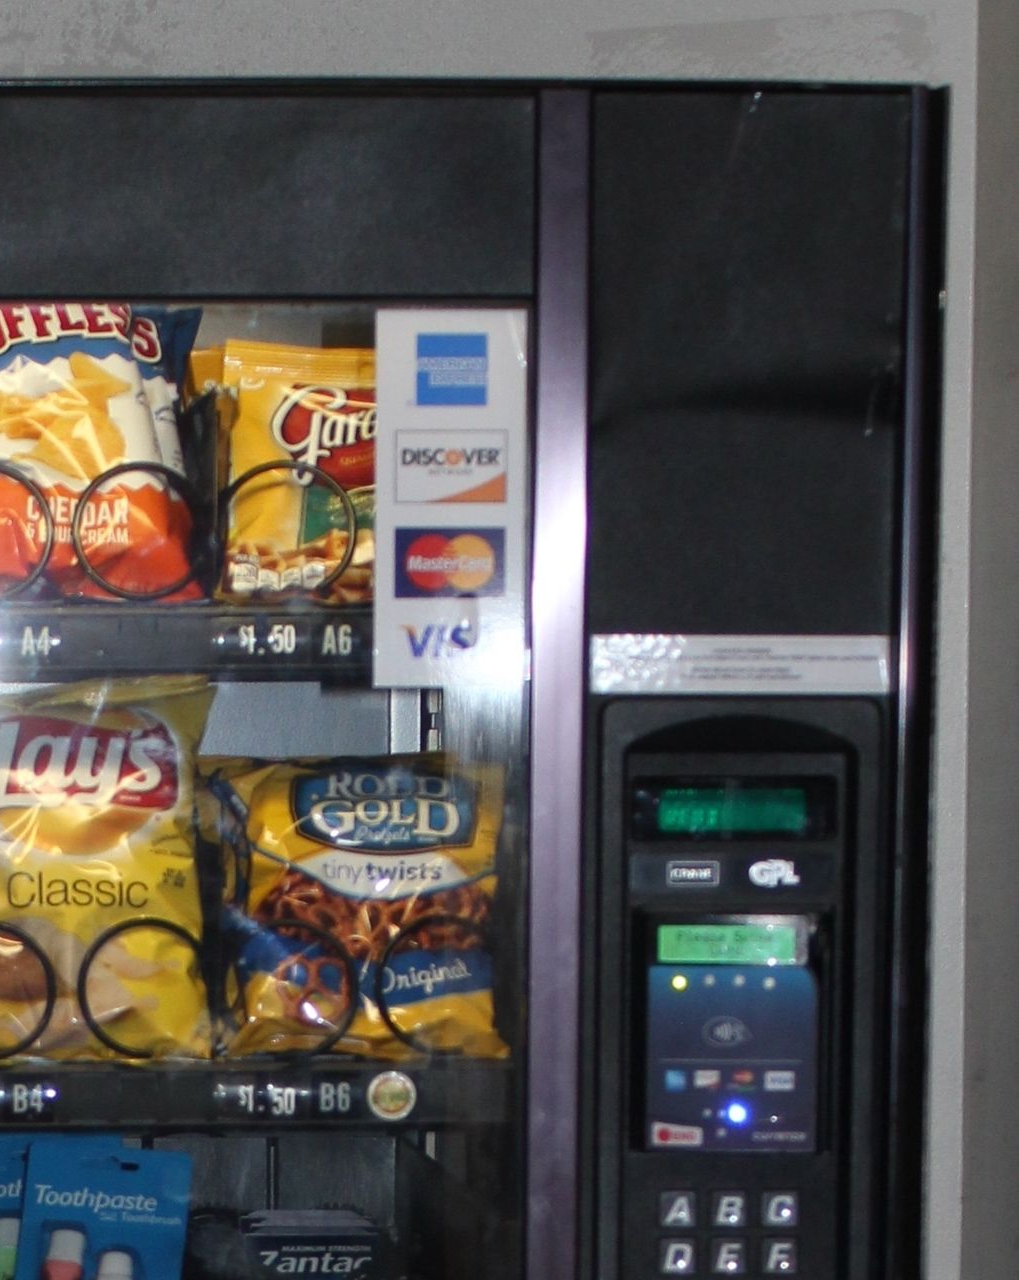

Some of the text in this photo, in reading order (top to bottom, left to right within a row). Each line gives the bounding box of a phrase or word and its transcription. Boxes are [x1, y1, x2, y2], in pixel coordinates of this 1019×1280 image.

[401, 448, 500, 466] DISCOVER
[407, 555, 493, 573] MasterCard
[21, 626, 52, 656] A4
[322, 625, 352, 655] A6
[326, 771, 452, 799] ROLD
[310, 798, 460, 837] GOLD
[322, 858, 444, 884] tiny twists
[6, 871, 149, 909] Classic
[13, 1084, 44, 1113] B4
[238, 1085, 296, 1115] $1.50
[319, 1083, 352, 1112] B6
[35, 1184, 158, 1213] Toothpaste
[664, 1194, 795, 1223] A B C
[663, 1243, 793, 1270] D E F
